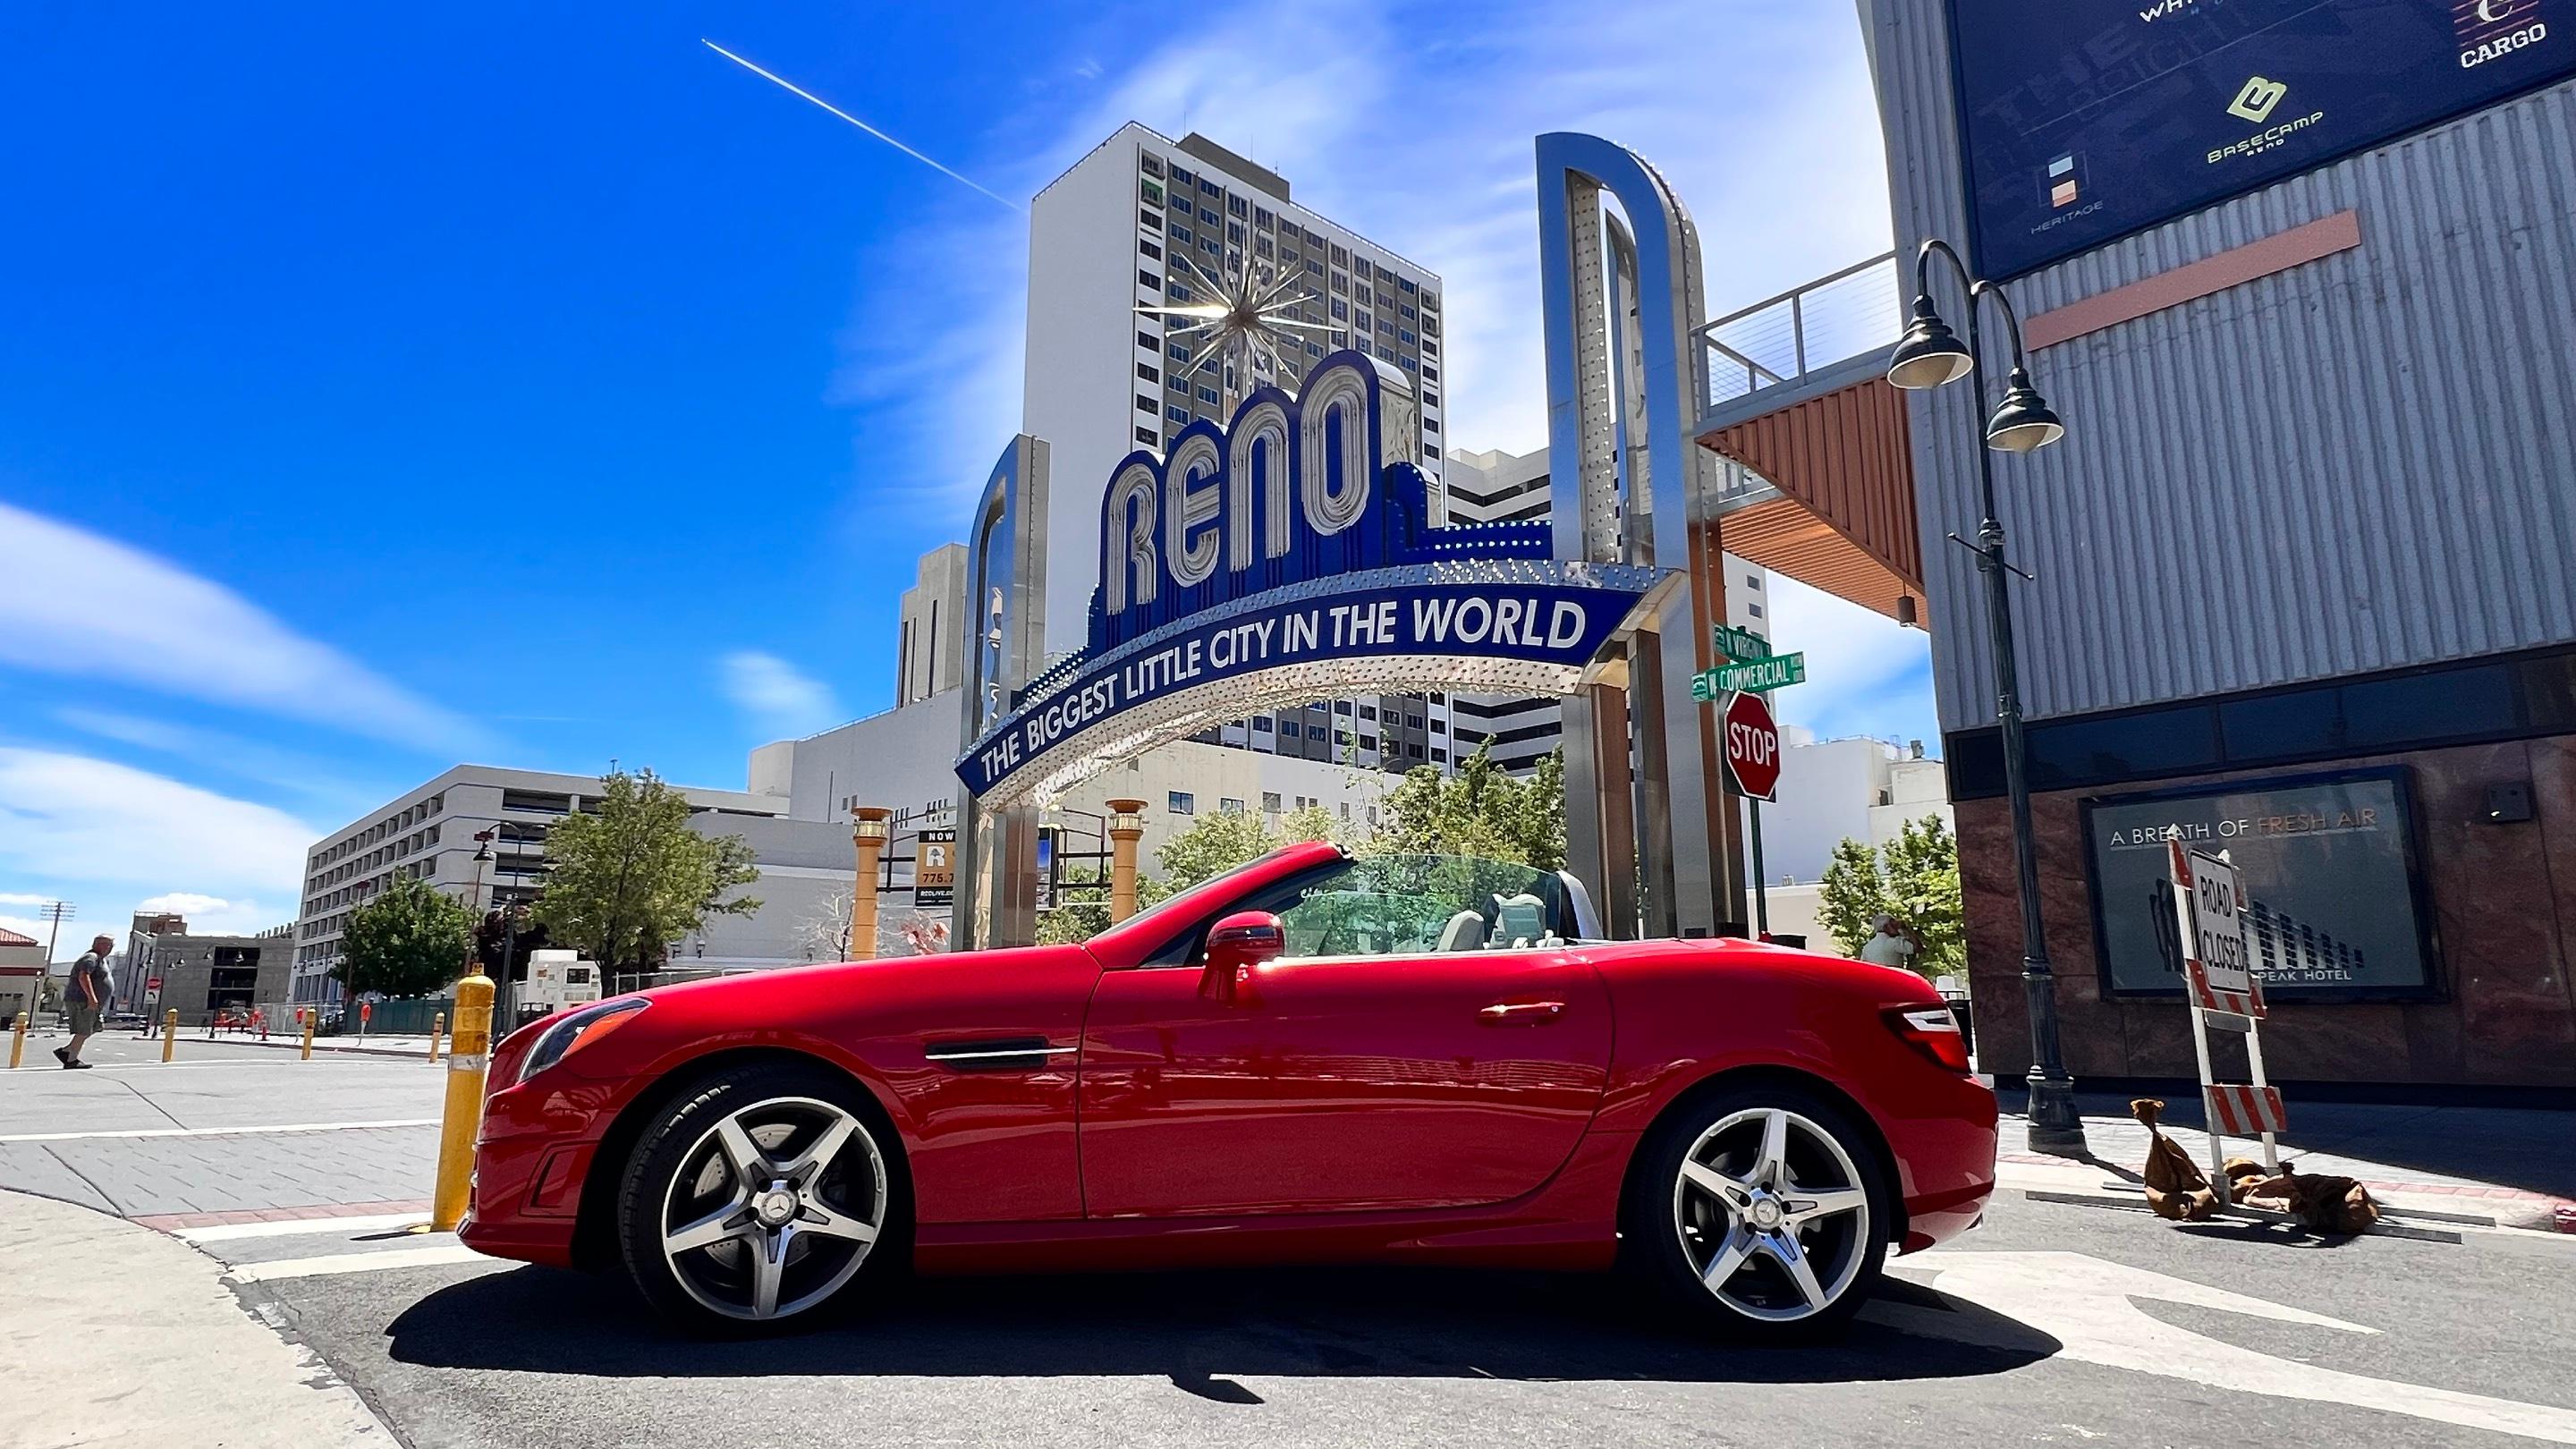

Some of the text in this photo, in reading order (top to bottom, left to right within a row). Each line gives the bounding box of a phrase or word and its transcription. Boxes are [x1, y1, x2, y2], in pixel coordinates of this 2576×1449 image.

[2461, 23, 2546, 68] CARGO
[2207, 111, 2324, 164] BASECAMP
[2030, 199, 2104, 234] HERITAGE
[980, 597, 1586, 783] THE BIGGEST LITTLE CITY IN THE WORLD
[1719, 660, 1790, 692] COMMERCIAL
[1731, 721, 1776, 767] STOP
[928, 833, 954, 841] NOW
[2111, 831, 2126, 846] A
[2218, 819, 2249, 837] OF
[2258, 813, 2326, 835] FRESH
[2337, 808, 2377, 828] AIR
[2199, 875, 2232, 918] ROAD
[2203, 929, 2245, 972] CLOSED
[2304, 970, 2352, 980] HOTEL
